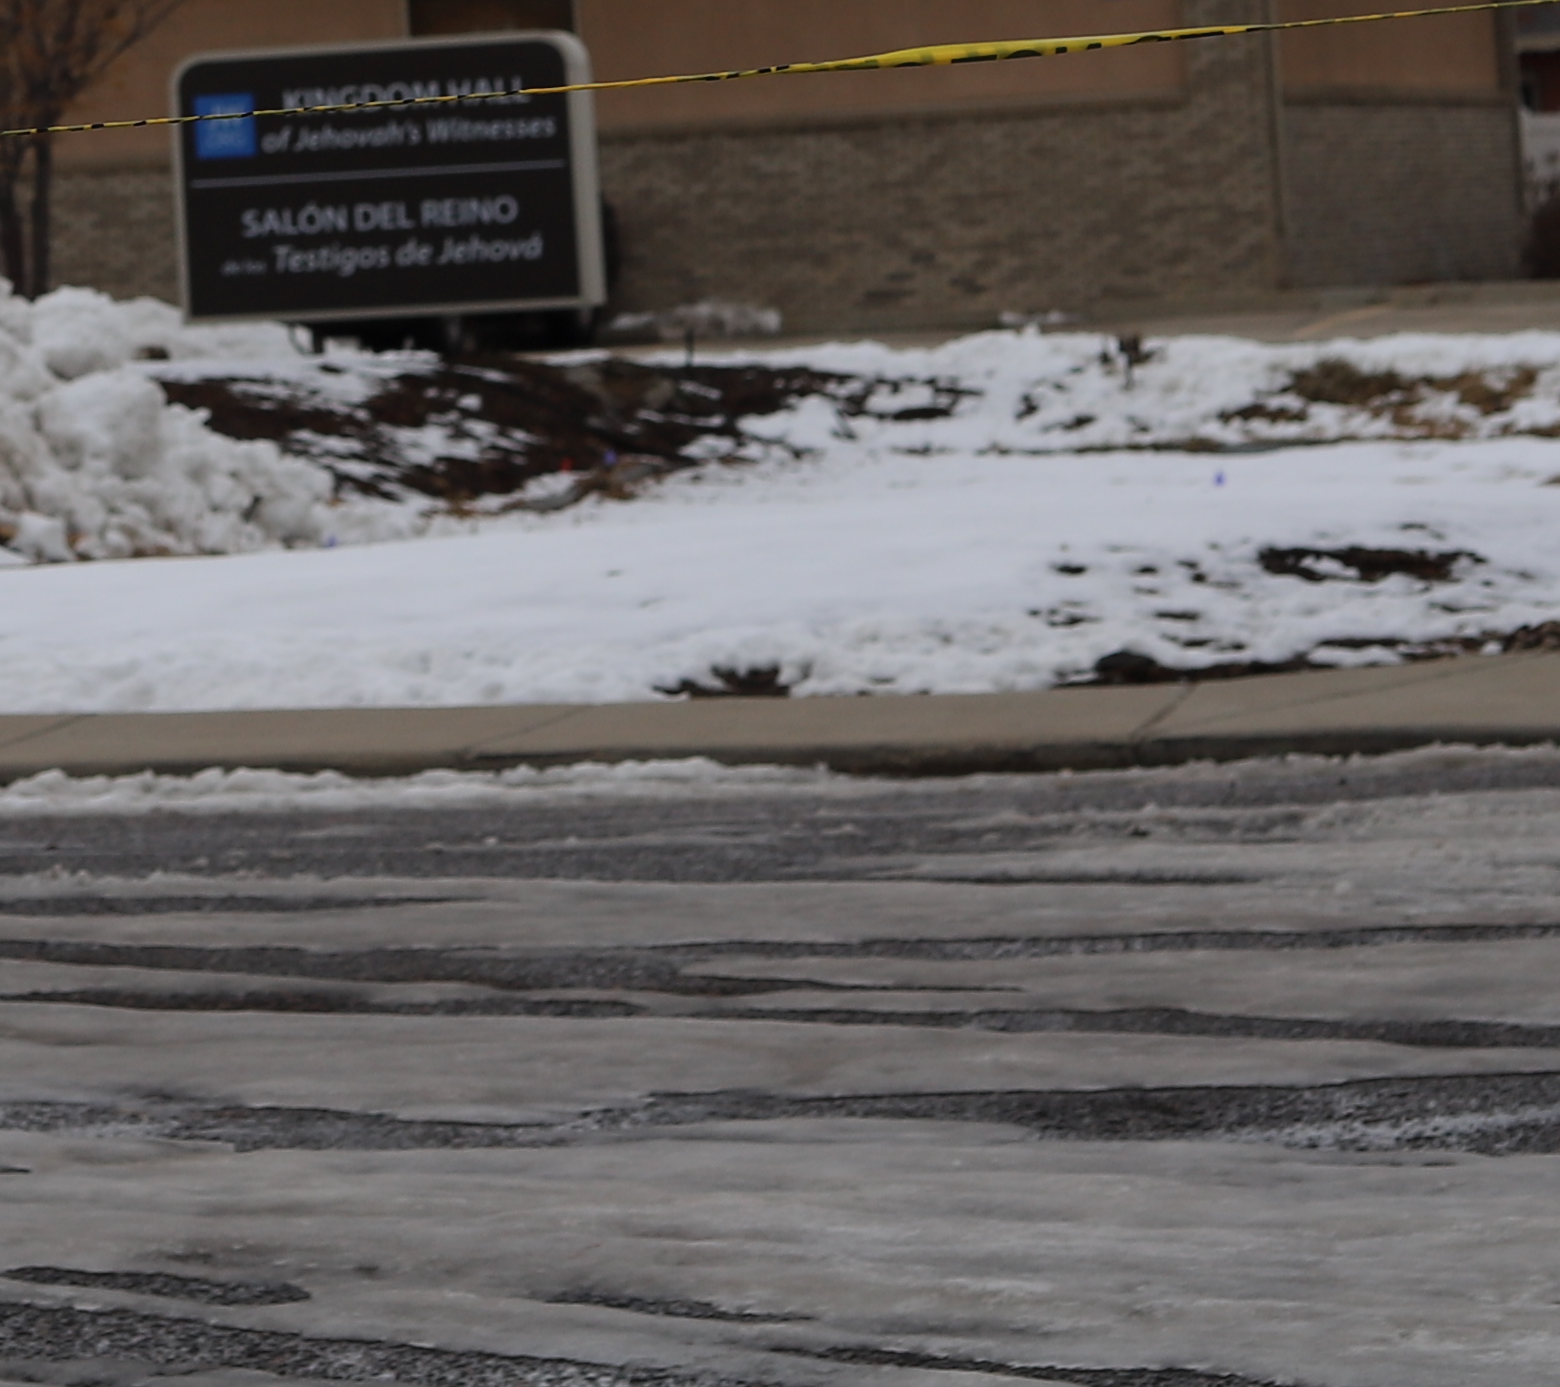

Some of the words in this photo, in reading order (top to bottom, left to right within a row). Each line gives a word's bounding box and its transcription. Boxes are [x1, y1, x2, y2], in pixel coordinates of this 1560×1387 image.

[282, 82, 440, 115] KINGDOM
[447, 76, 531, 106] HALL
[261, 125, 291, 155] of
[292, 120, 421, 154] Jehovah's
[425, 116, 557, 144] Witnesses
[240, 201, 348, 238] SALÓN
[353, 201, 416, 233] DEL
[420, 194, 519, 229] REINO
[273, 243, 390, 277] Testigos
[394, 236, 432, 266] de
